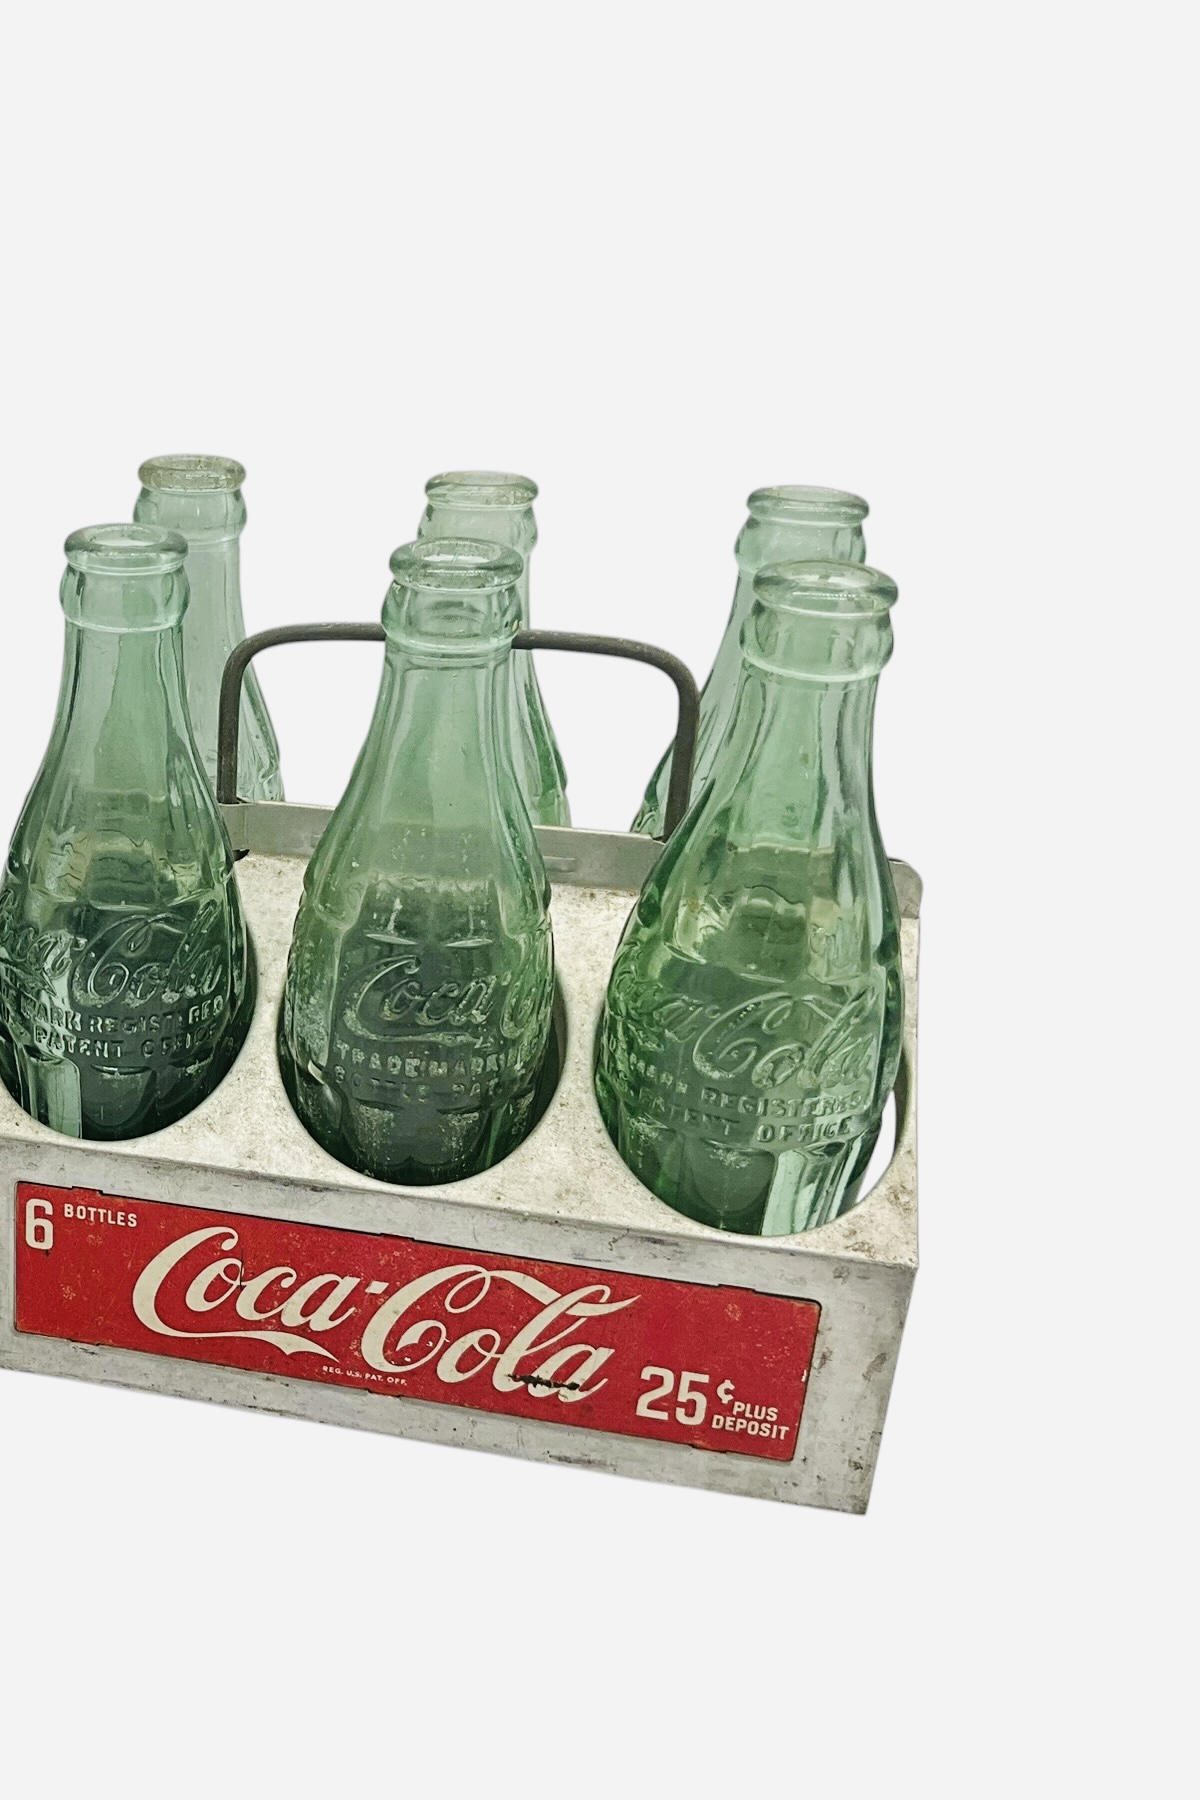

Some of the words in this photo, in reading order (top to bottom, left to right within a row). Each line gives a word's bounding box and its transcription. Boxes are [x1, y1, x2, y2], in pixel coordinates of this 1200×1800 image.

[24, 1198, 54, 1250] 6
[63, 1203, 138, 1228] BOTTLES
[132, 1226, 642, 1403] Coca-Cola
[711, 1415, 790, 1440] DEPOSIT
[733, 1401, 779, 1422] PLUS
